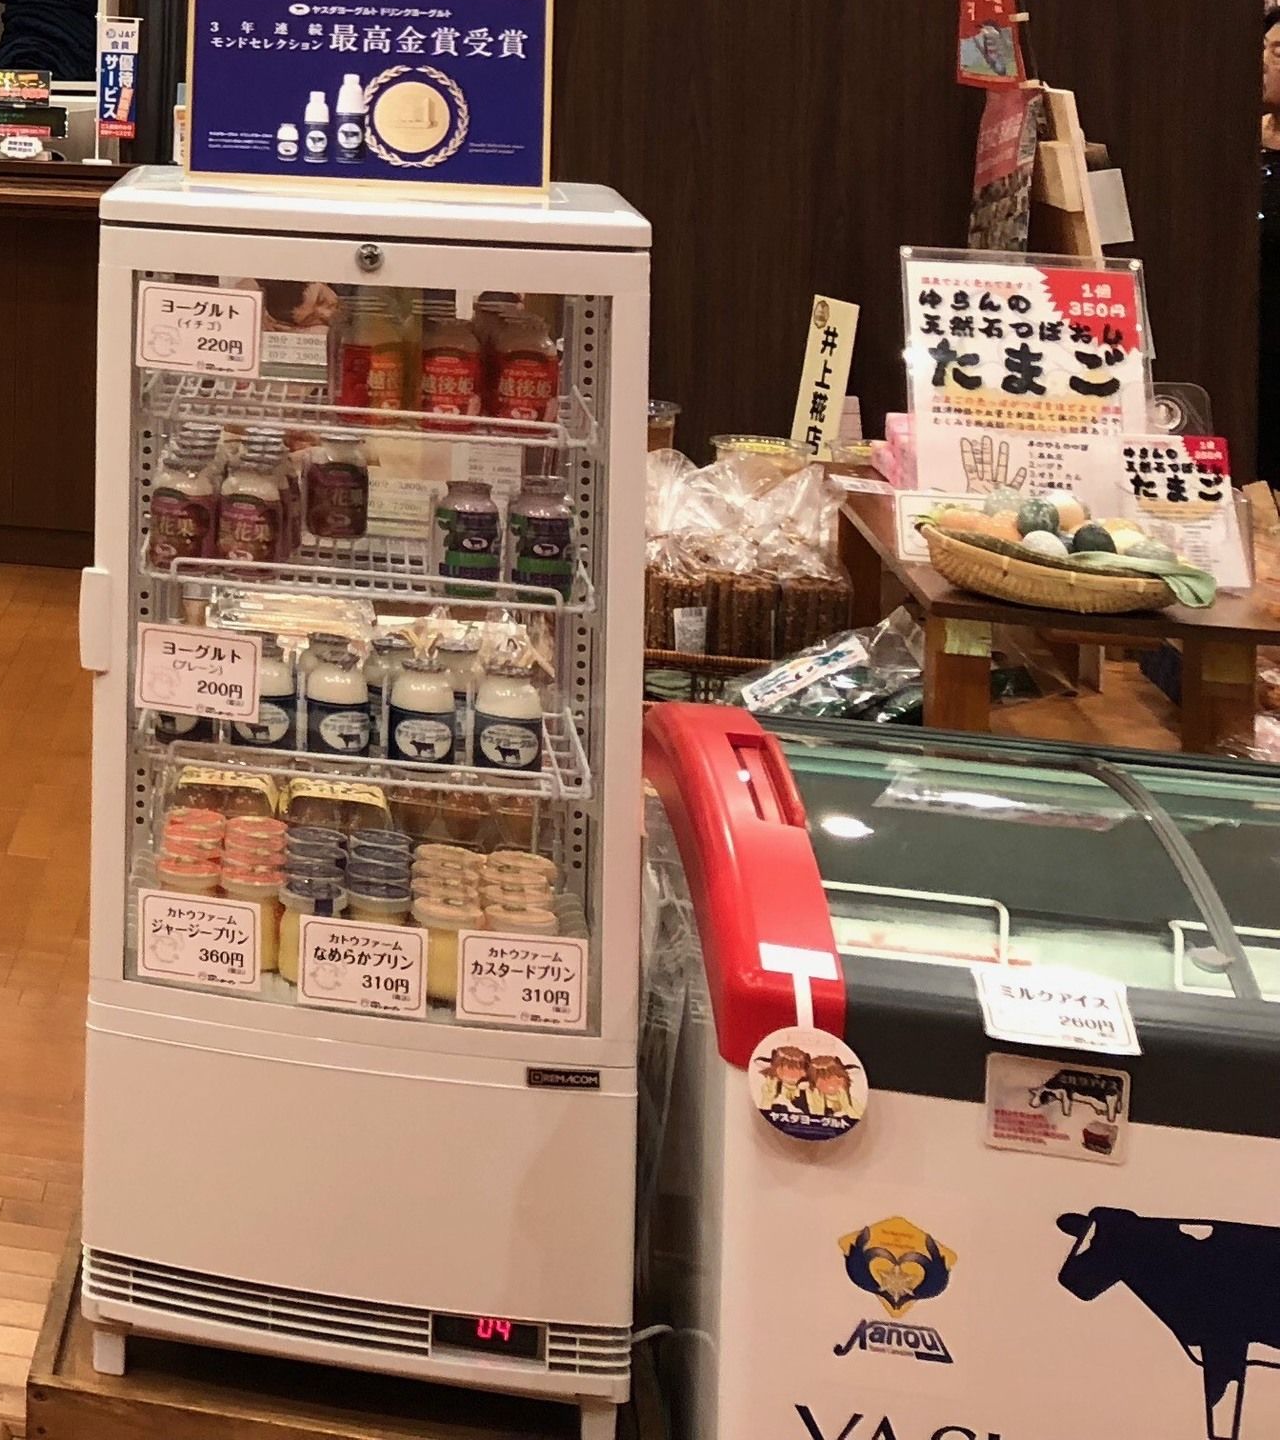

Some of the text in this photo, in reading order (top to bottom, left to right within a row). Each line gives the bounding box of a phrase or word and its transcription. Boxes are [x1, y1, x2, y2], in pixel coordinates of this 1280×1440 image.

[311, 5, 378, 17] ヤスダヨーグルト
[111, 41, 130, 50] 会員
[118, 31, 137, 39] JAF
[210, 36, 324, 52] モンドセレクション
[328, 23, 529, 60] 最高金賞受賞
[103, 53, 118, 119] サービス
[161, 299, 240, 320] ヨーグルト
[1068, 301, 1127, 318] 350円
[920, 313, 1124, 346] 天然石つぼおし
[197, 336, 243, 355] 220円
[928, 337, 1126, 398] たまご
[498, 376, 553, 399] 越後姫
[1129, 474, 1224, 503] たまご
[161, 640, 242, 664] ヨーグルト
[197, 679, 243, 699] 200円
[165, 906, 238, 926] カトウファーム
[150, 919, 250, 946] ジャージープリン
[328, 932, 404, 952] カトウファーム
[198, 948, 245, 968] 360円
[313, 946, 415, 971] なめらかプリン
[487, 946, 563, 963] カトウファーム
[470, 960, 577, 984] カスタードプリン
[361, 974, 411, 995] 310円
[521, 988, 570, 1007] 310円
[998, 983, 1111, 1011] ミルクアイス
[1057, 1014, 1116, 1035] 260円
[768, 1109, 852, 1130] ヤスダヨーグルト
